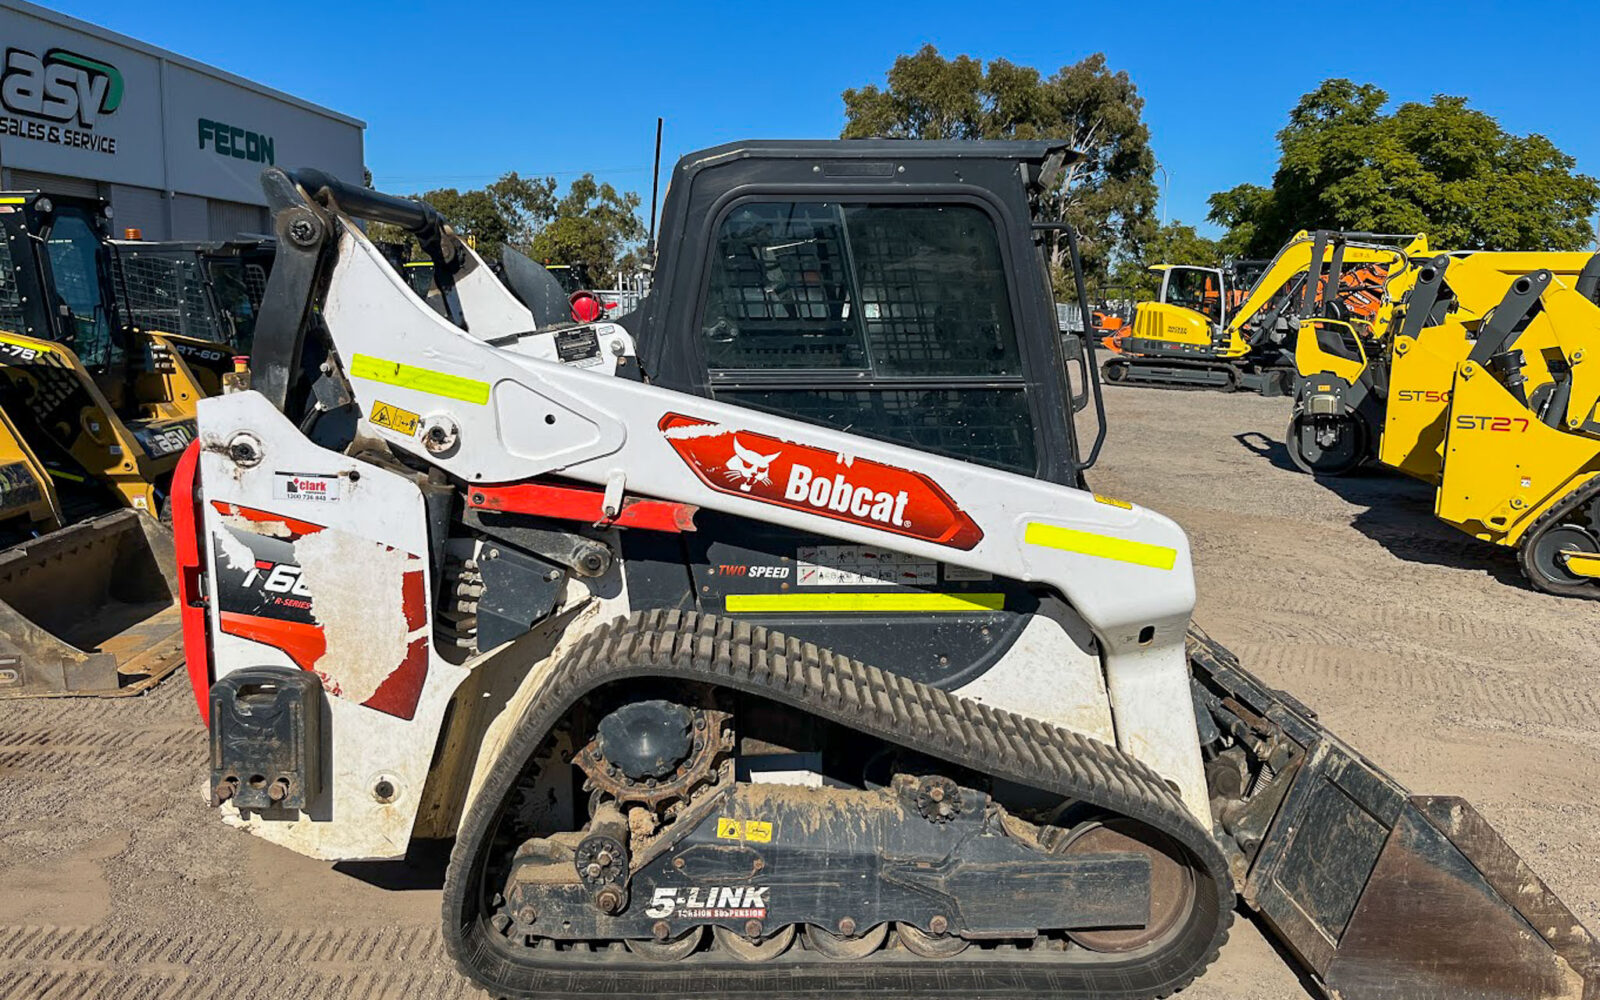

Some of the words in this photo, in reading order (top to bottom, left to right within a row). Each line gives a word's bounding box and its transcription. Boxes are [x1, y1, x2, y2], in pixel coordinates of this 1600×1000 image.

[48, 126, 61, 144] &
[64, 129, 115, 154] SERVICE
[199, 118, 274, 166] FECON
[0, 342, 36, 360] -75
[1456, 415, 1529, 433] ST27
[299, 480, 327, 491] clark
[784, 463, 910, 527] Bobcat
[719, 565, 746, 577] TWO
[748, 566, 790, 579] SPEED
[274, 597, 312, 610] R-SERIES
[645, 886, 770, 919] 5-LINK
